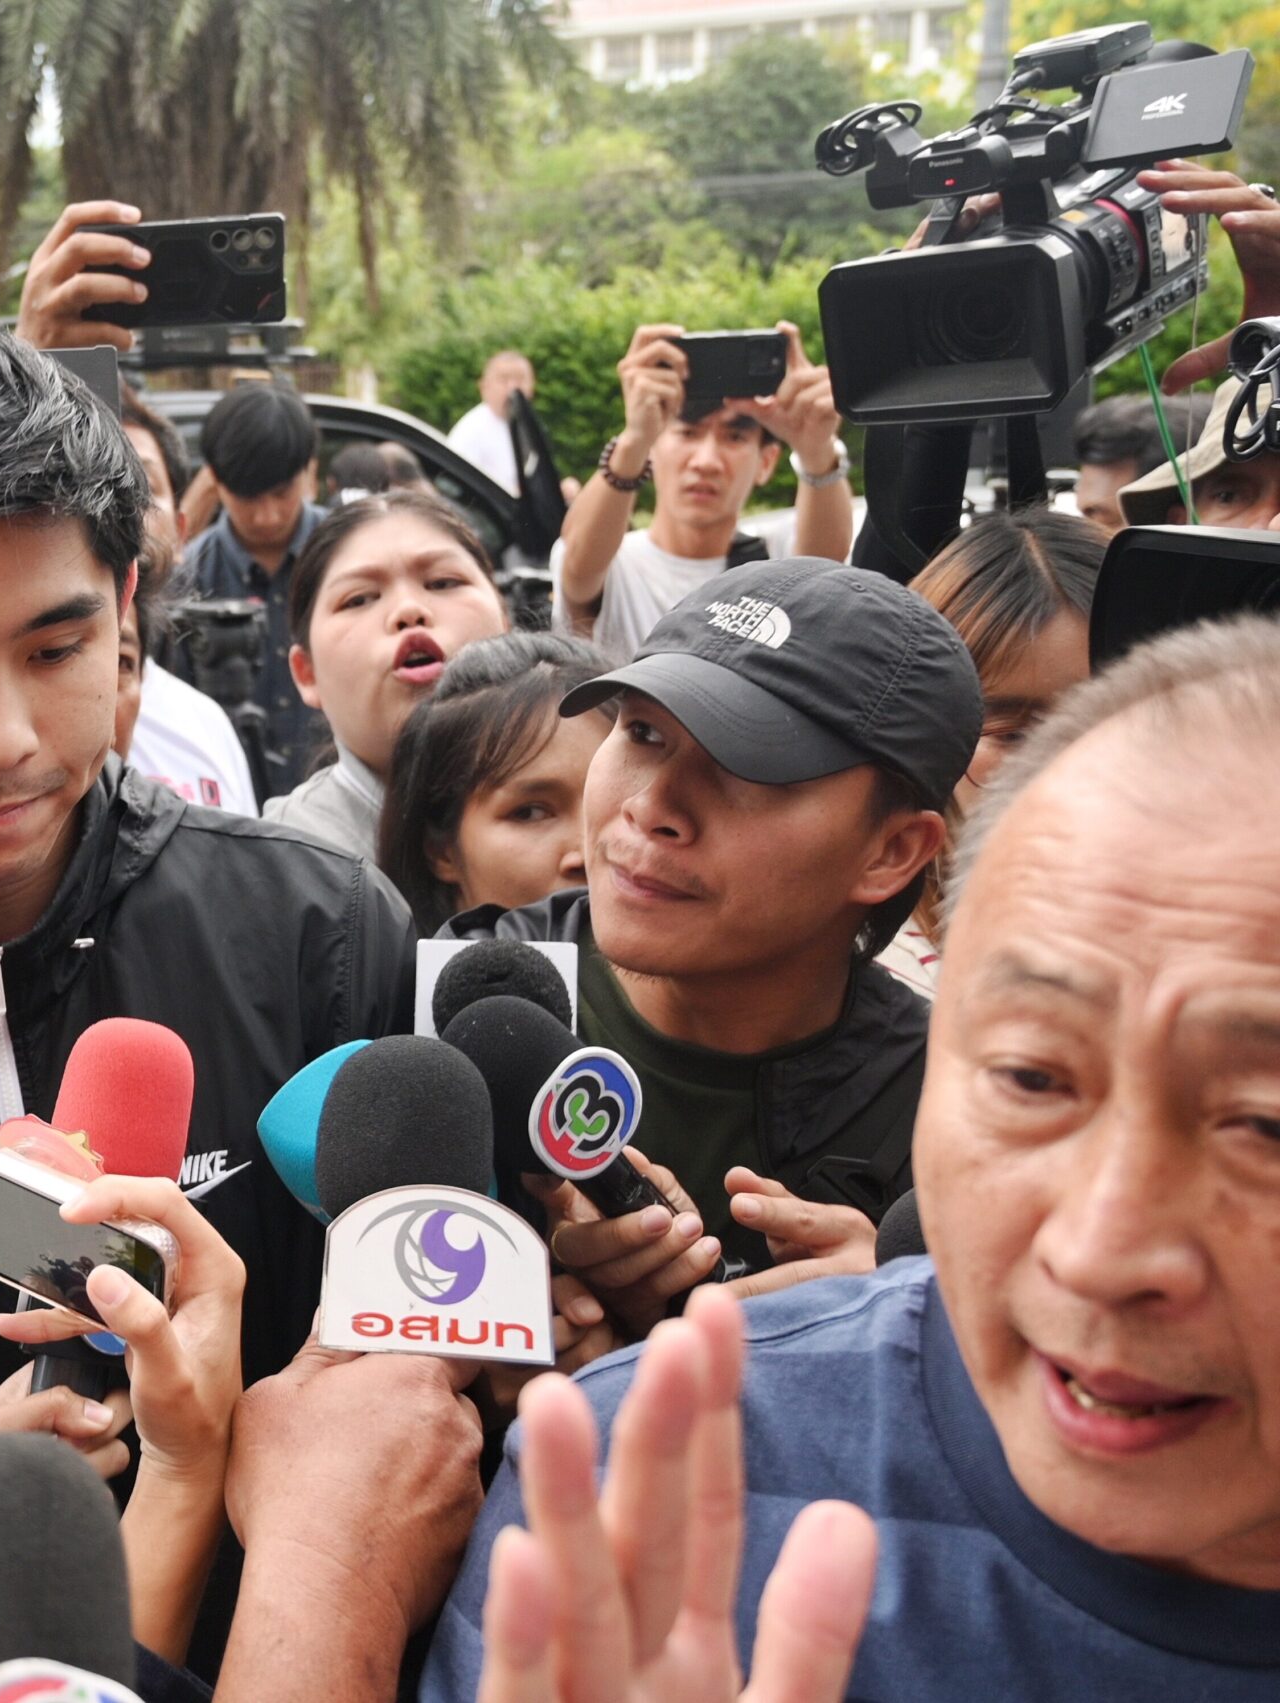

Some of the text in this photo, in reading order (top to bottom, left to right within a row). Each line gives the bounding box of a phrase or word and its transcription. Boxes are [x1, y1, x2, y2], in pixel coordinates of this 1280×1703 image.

[1143, 93, 1188, 113] 4K
[928, 157, 964, 168] Panasonic
[704, 601, 766, 627] NORTH
[738, 596, 773, 614] THE
[707, 613, 752, 638] FACE
[179, 1150, 228, 1186] NIKE
[351, 1311, 534, 1350] อสมท
